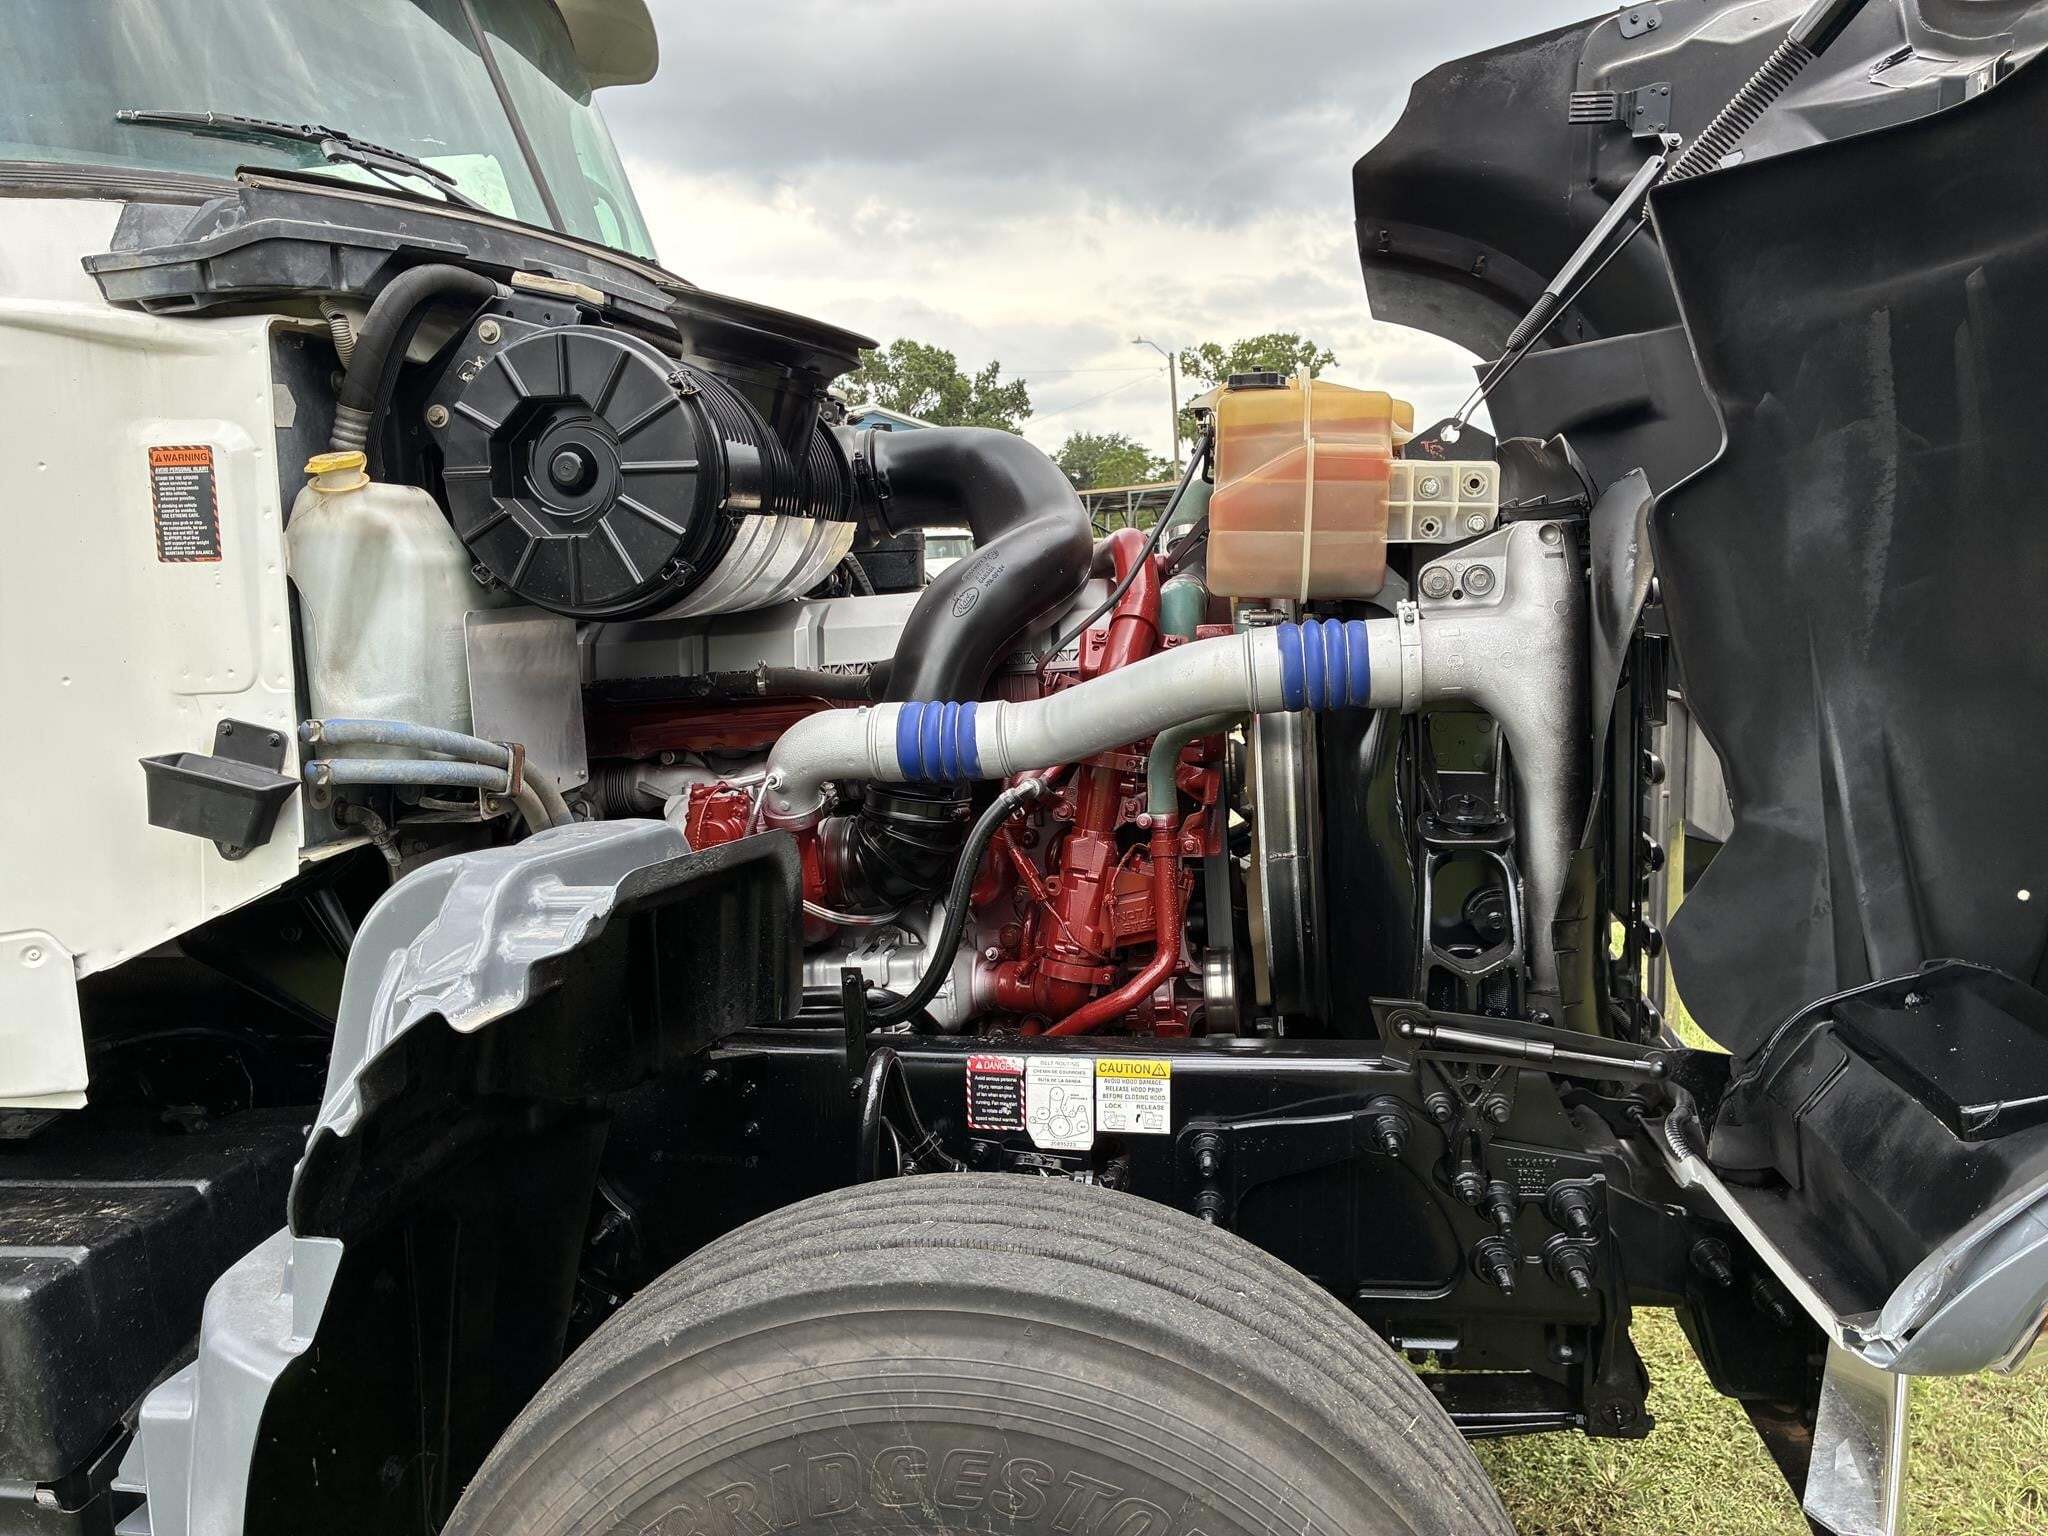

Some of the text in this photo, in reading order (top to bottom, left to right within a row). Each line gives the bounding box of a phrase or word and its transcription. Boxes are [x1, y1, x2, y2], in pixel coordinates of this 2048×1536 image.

[163, 452, 208, 462] WARNING
[1117, 908, 1144, 921] NOT
[984, 1060, 1016, 1071] DANGER
[1099, 1062, 1150, 1074] CAUTION
[640, 1446, 1209, 1536] BRIDGESTO
